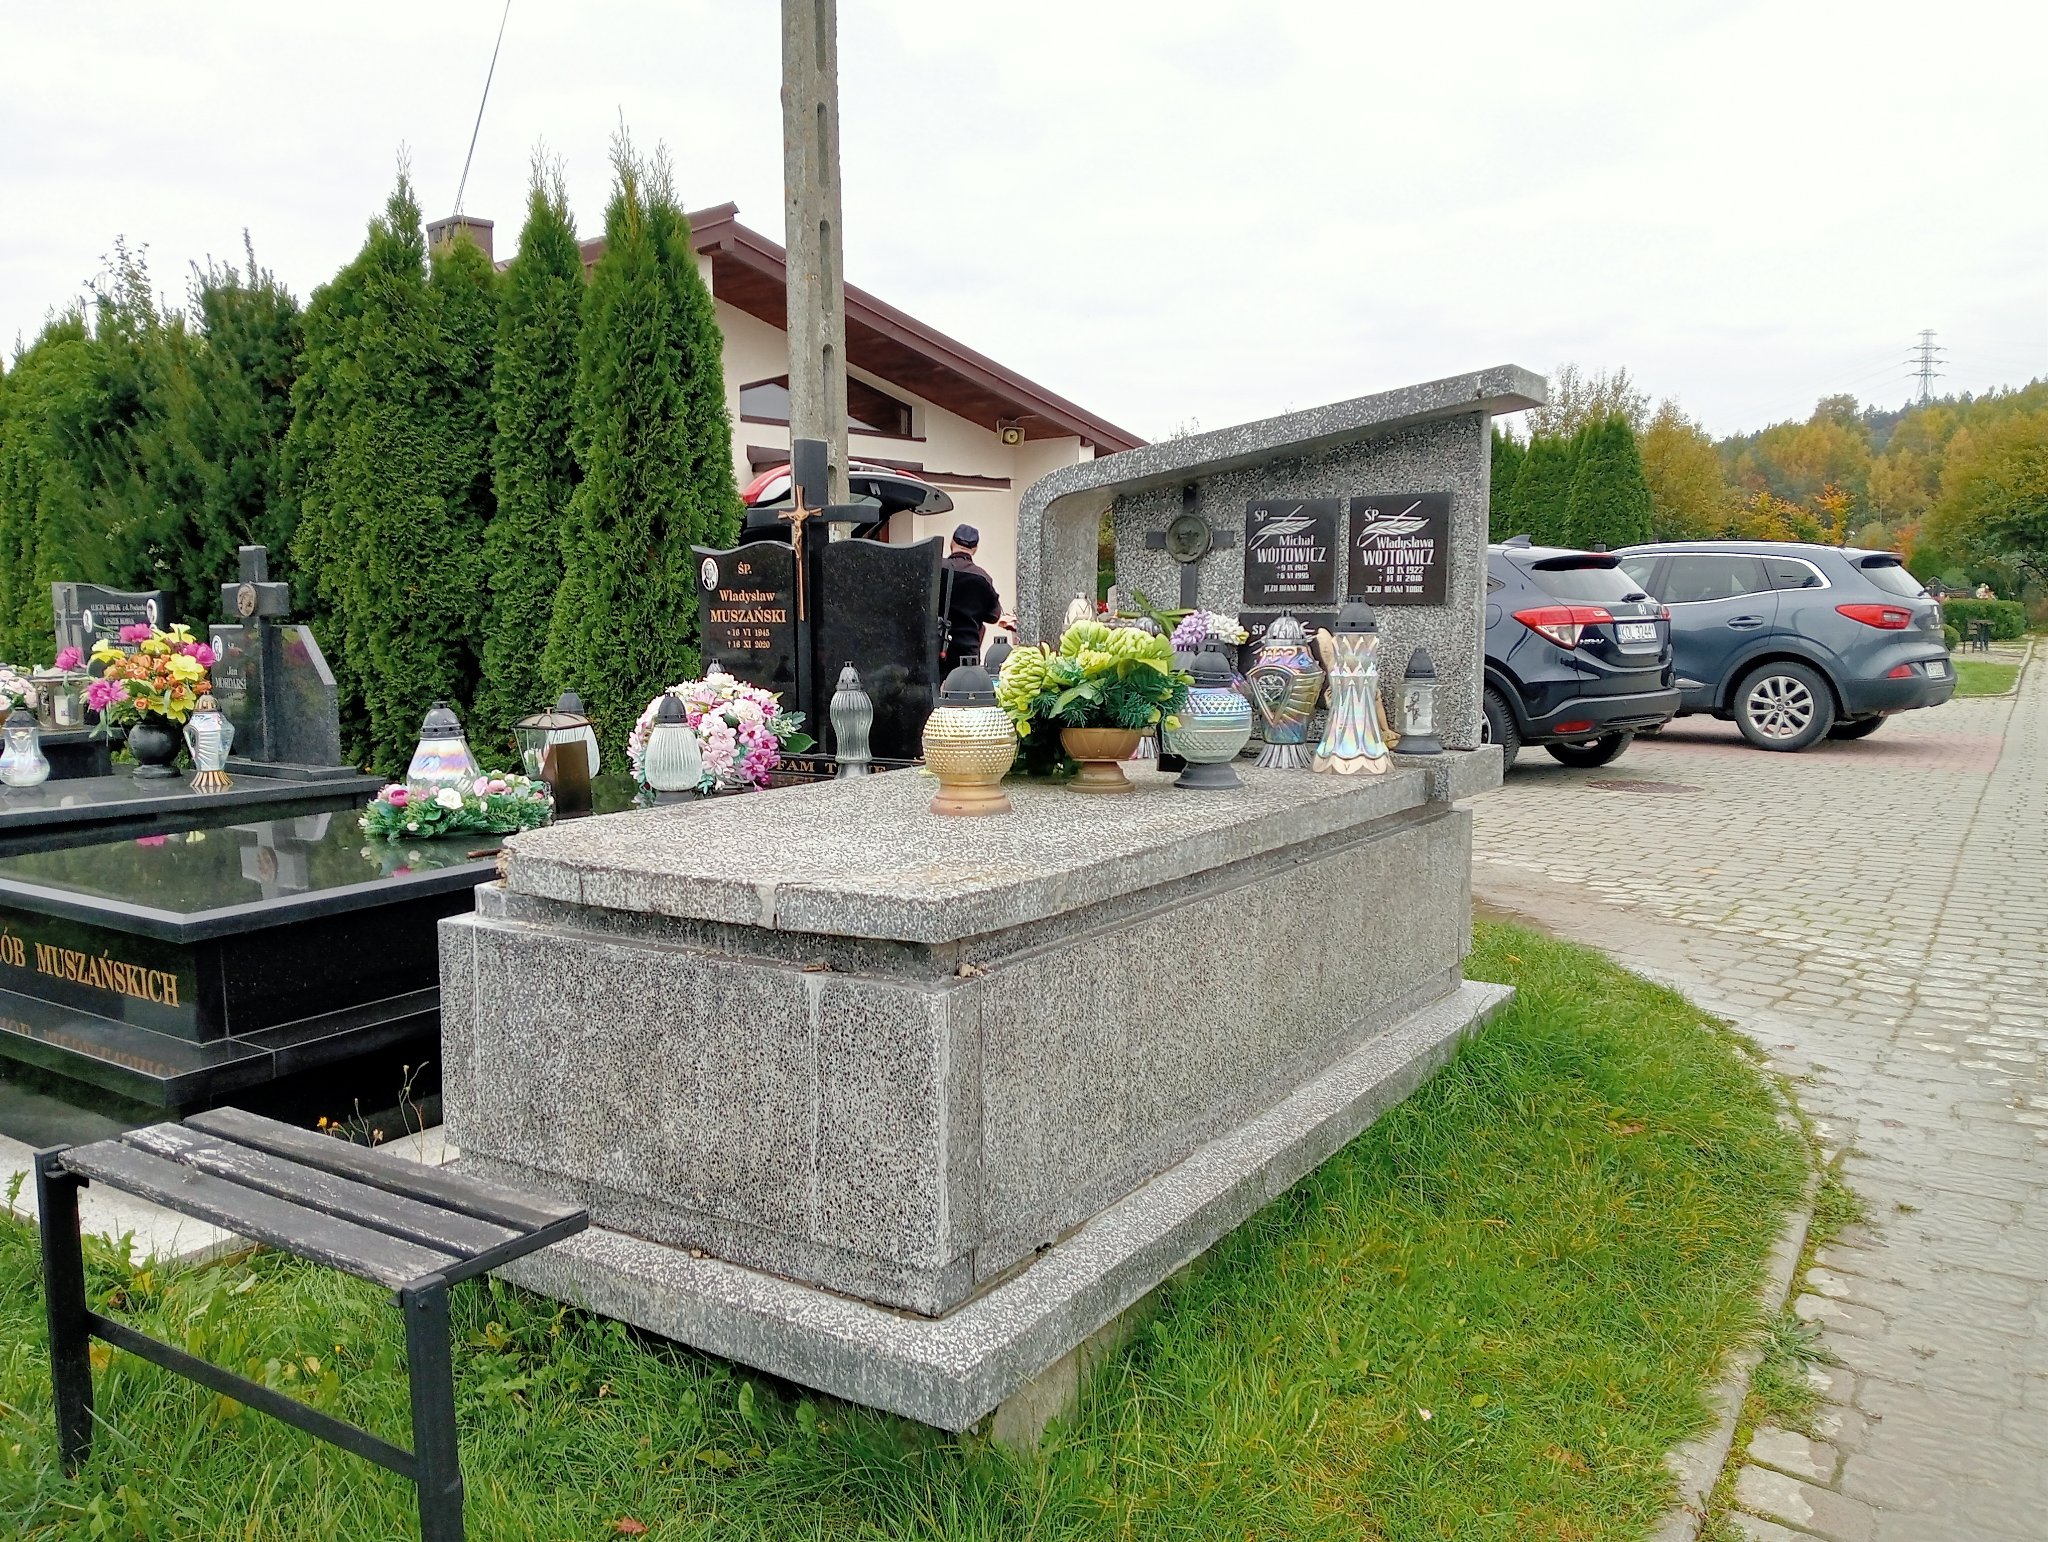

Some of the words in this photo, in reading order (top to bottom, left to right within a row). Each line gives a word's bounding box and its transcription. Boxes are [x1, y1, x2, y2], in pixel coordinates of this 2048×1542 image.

[1254, 507, 1268, 521] ŚP
[1365, 505, 1379, 521] ŚP
[1257, 546, 1327, 564] WÓJTOWICZ
[1406, 565, 1424, 575] 1922
[710, 606, 787, 623] MUSZAŃSKI
[1252, 622, 1266, 635] ŚP
[776, 759, 815, 773] FAM
[0, 926, 27, 968] ÓB
[34, 942, 180, 1008] MUSZAŃSKICH
